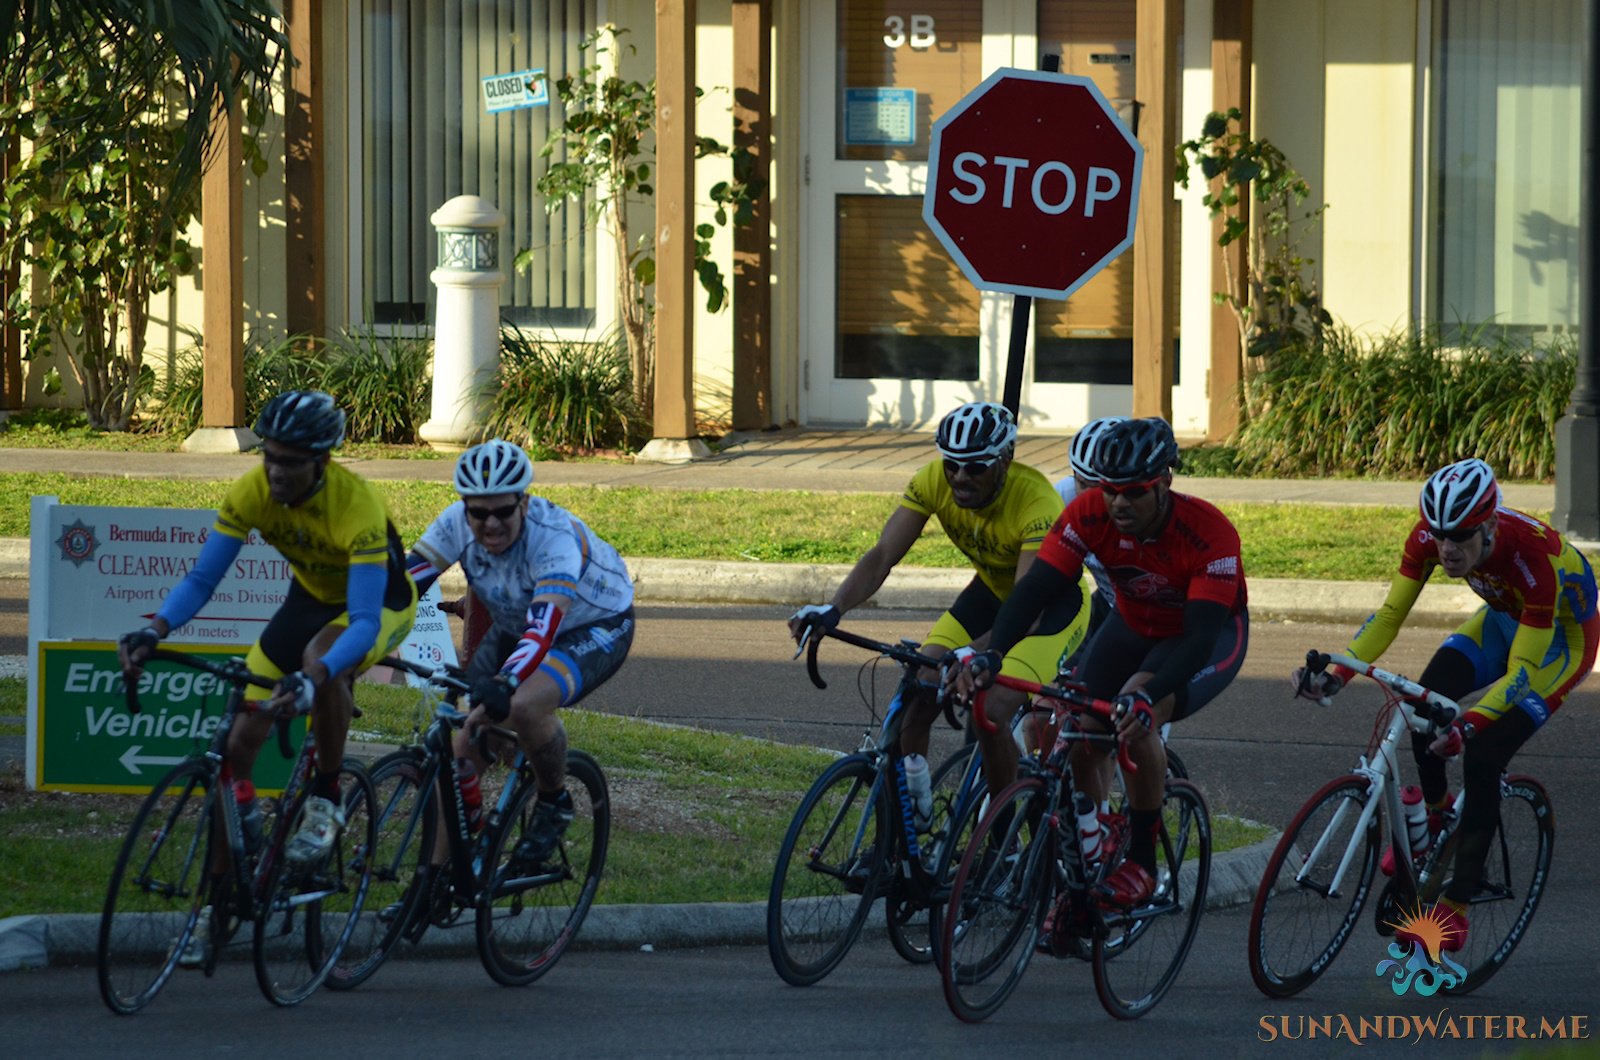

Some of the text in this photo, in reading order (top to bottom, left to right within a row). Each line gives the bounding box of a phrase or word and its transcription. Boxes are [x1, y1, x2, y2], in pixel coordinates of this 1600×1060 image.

[883, 14, 937, 49] 3B
[485, 77, 523, 98] CLOSED
[948, 151, 1122, 219] STOP
[109, 524, 208, 544] Bermuda Fire &
[98, 554, 226, 578] CLEARWAT
[235, 559, 294, 581] STATI
[104, 585, 155, 602] Airport
[238, 590, 288, 605] Divisio
[171, 624, 240, 639] 00 meters
[414, 622, 444, 633] ROGRESS
[63, 662, 228, 702] Emerge
